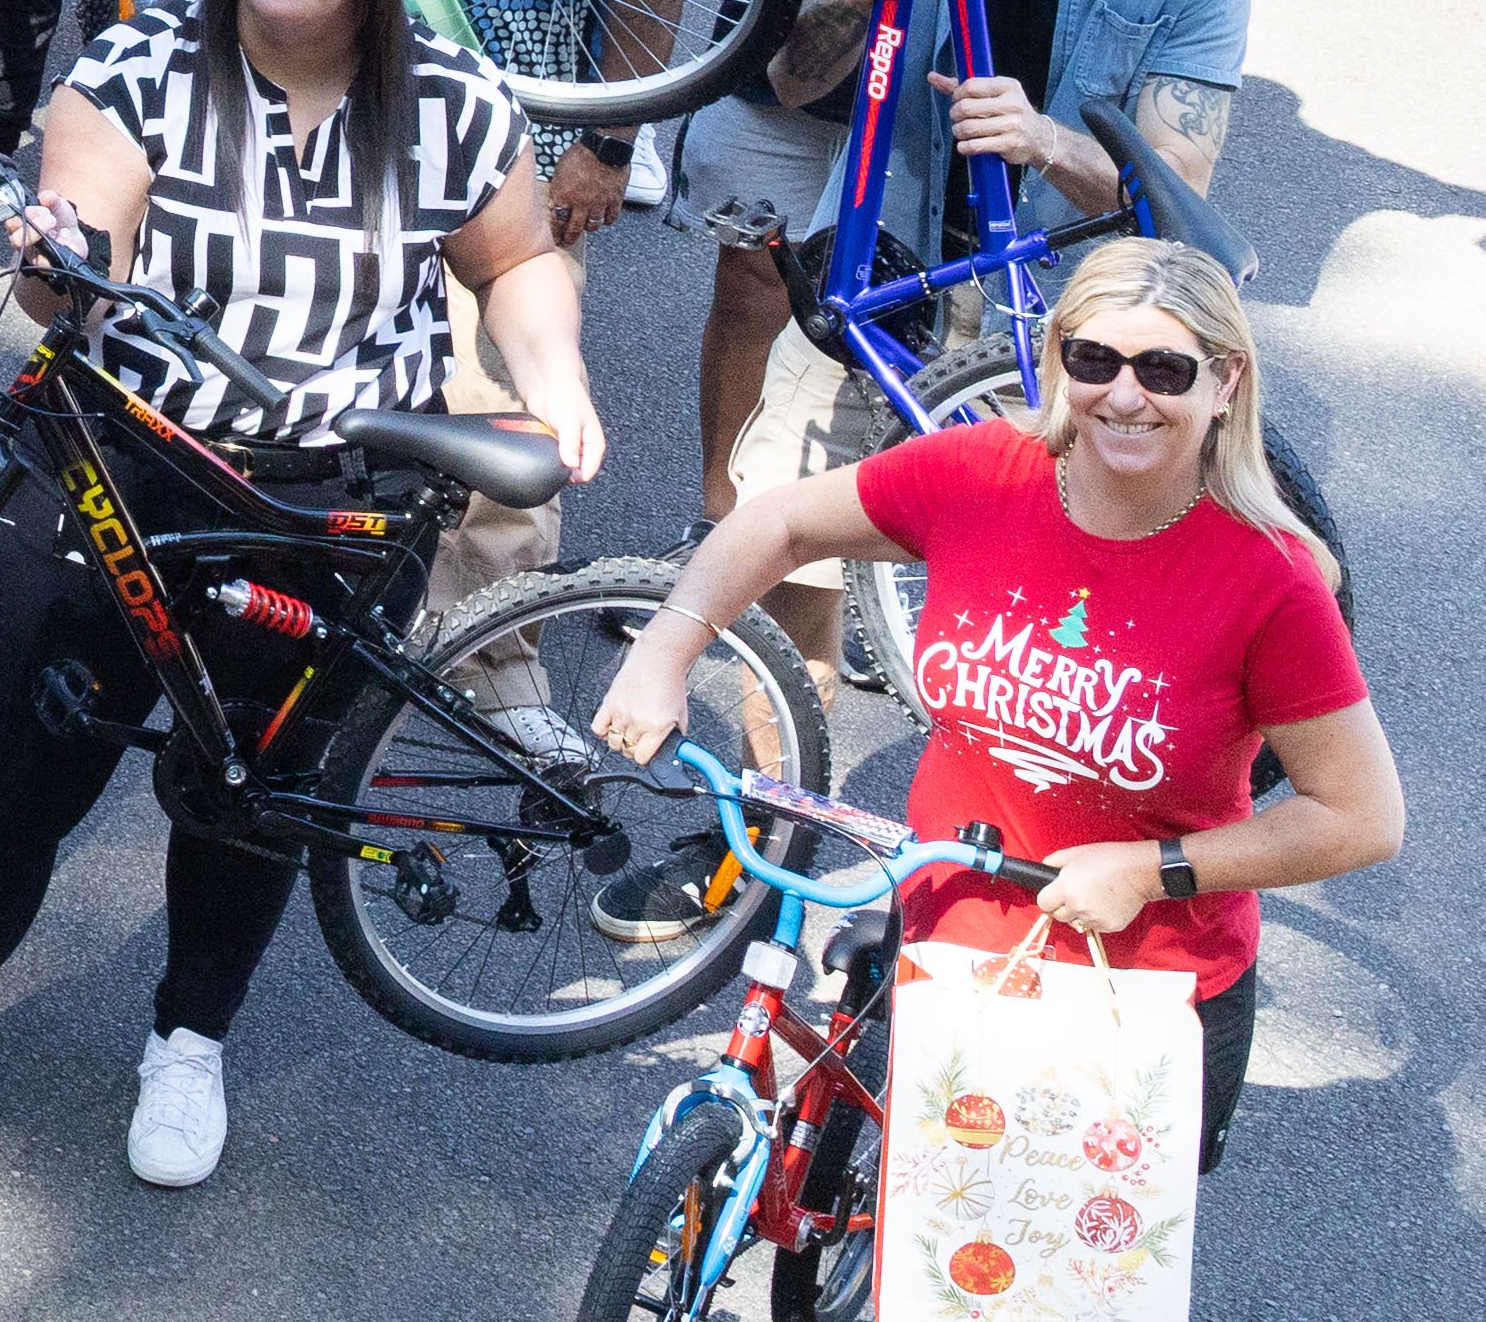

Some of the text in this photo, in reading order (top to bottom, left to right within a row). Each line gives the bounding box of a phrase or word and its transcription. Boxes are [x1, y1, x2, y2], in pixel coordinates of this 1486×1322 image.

[868, 23, 902, 101] Repco
[125, 390, 178, 444] TRAXX
[60, 461, 181, 660] CYCLOPS
[962, 615, 1140, 713] MERRY
[916, 642, 1166, 792] CHRISTMAS
[1002, 1135, 1086, 1171] Peace
[1006, 1178, 1074, 1212] Love
[1005, 1217, 1073, 1259] Joy
